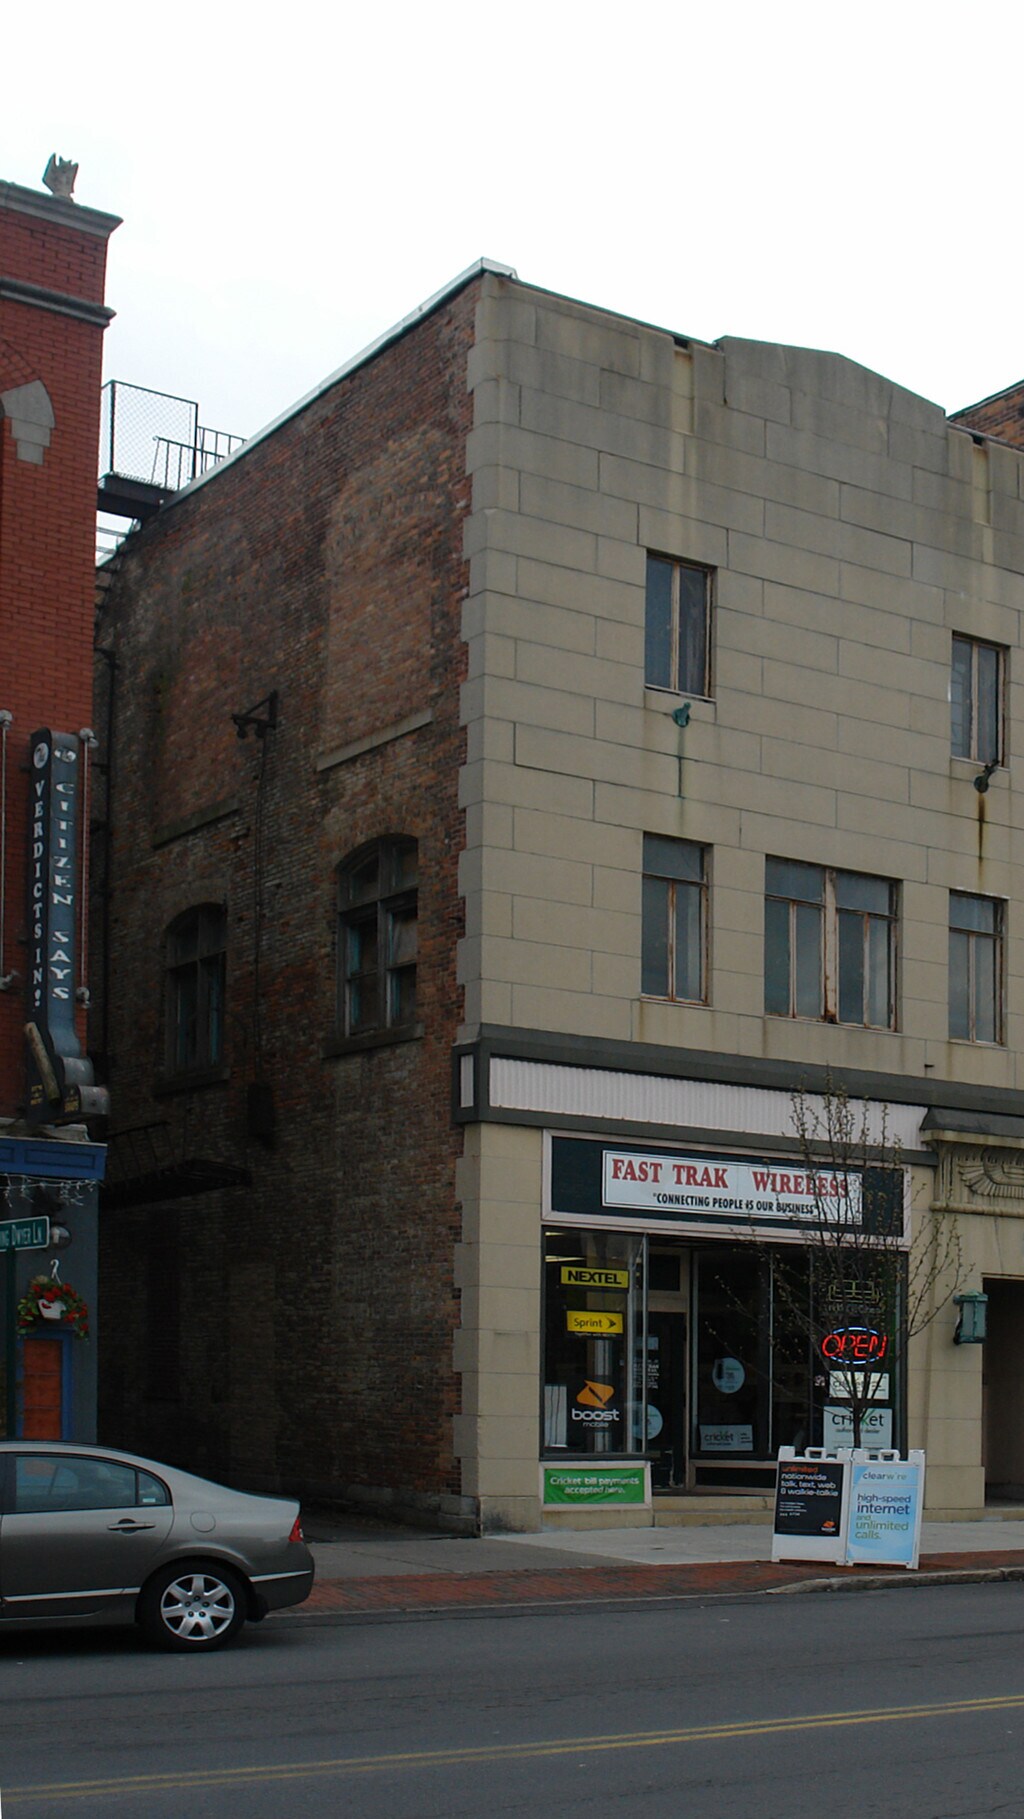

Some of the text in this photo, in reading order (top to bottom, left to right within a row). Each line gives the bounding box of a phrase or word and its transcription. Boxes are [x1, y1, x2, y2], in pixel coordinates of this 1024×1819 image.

[32, 780, 45, 939] VERDICTS
[50, 783, 75, 999] CITIZEN SAYS
[612, 1158, 850, 1199] FAST TRAK WIRELESS
[712, 1197, 743, 1210] PEOPLE
[745, 1200, 754, 1210] IS
[756, 1201, 774, 1211] OUR
[567, 1270, 622, 1284] NEXTEL
[574, 1318, 602, 1328] Sprint
[822, 1334, 887, 1357] OPEN
[571, 1408, 620, 1421] boost
[832, 1409, 885, 1427] criket
[704, 1431, 734, 1442] cricket
[550, 1477, 640, 1486] Cricket bill payments
[564, 1486, 604, 1494] accepted
[788, 1488, 838, 1497] walkie-talkie
[857, 1493, 911, 1503] high-speed
[857, 1502, 910, 1515] internet
[856, 1520, 909, 1531] unlimited
[855, 1530, 881, 1540] calls.
